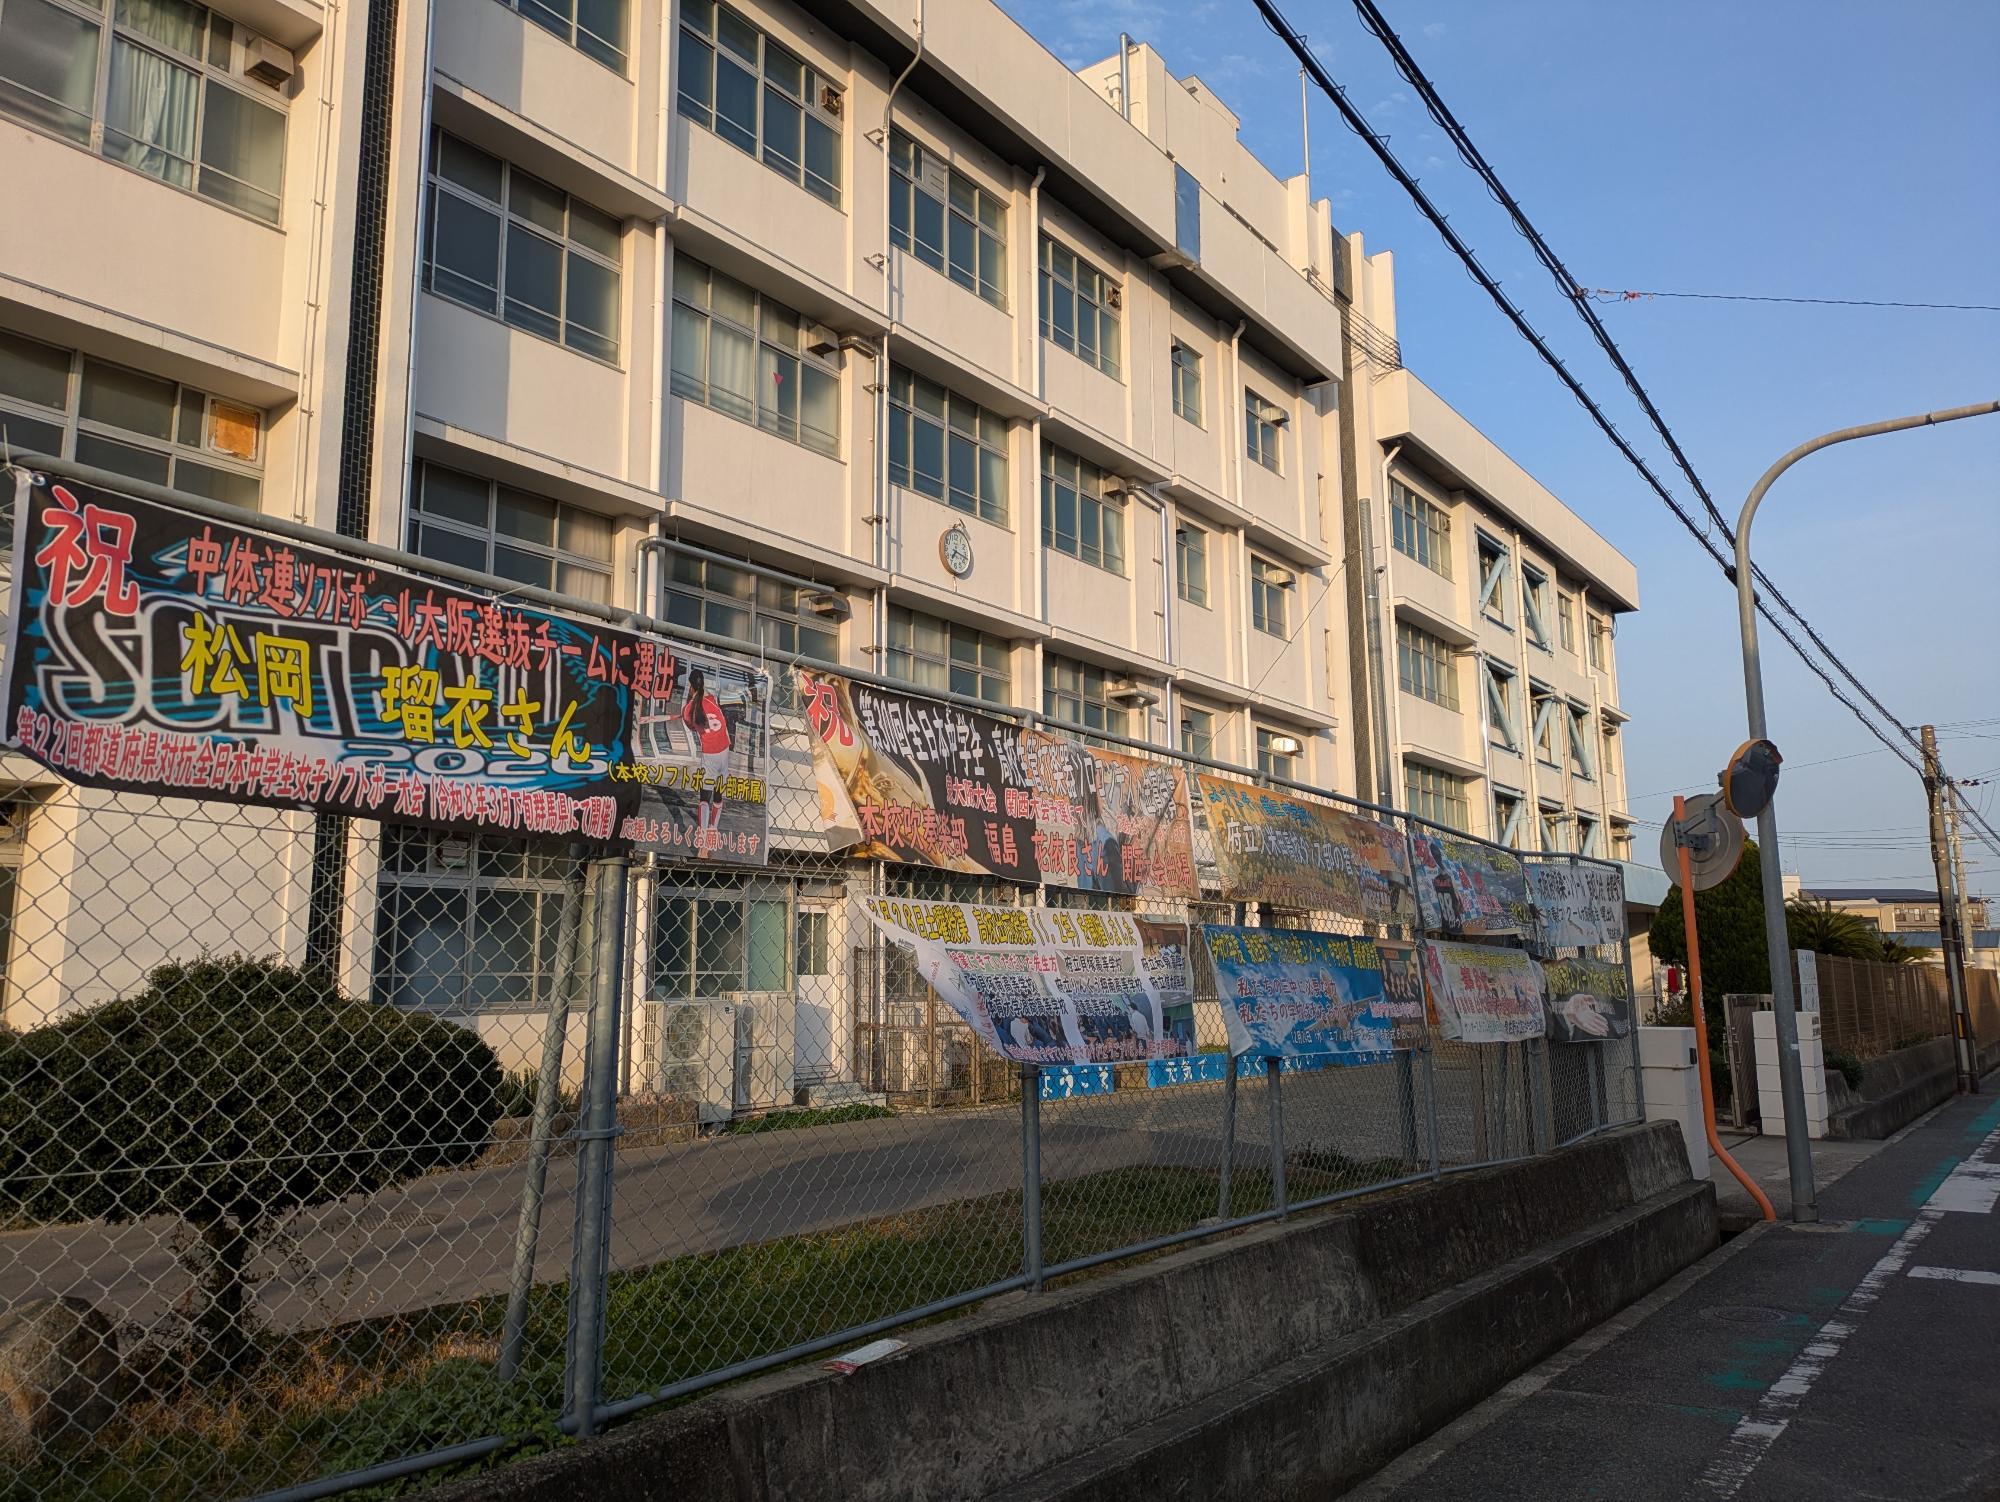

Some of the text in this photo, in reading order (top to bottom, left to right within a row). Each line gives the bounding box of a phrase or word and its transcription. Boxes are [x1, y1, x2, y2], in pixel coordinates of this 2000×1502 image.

[35, 485, 139, 616] 祝
[181, 611, 591, 763] 松岡 瑠衣さん
[801, 672, 854, 747] 祝
[620, 815, 761, 855] 応援よろしくお願いします
[858, 795, 968, 861] 本校吹奏楽部
[984, 819, 1020, 868] 福島
